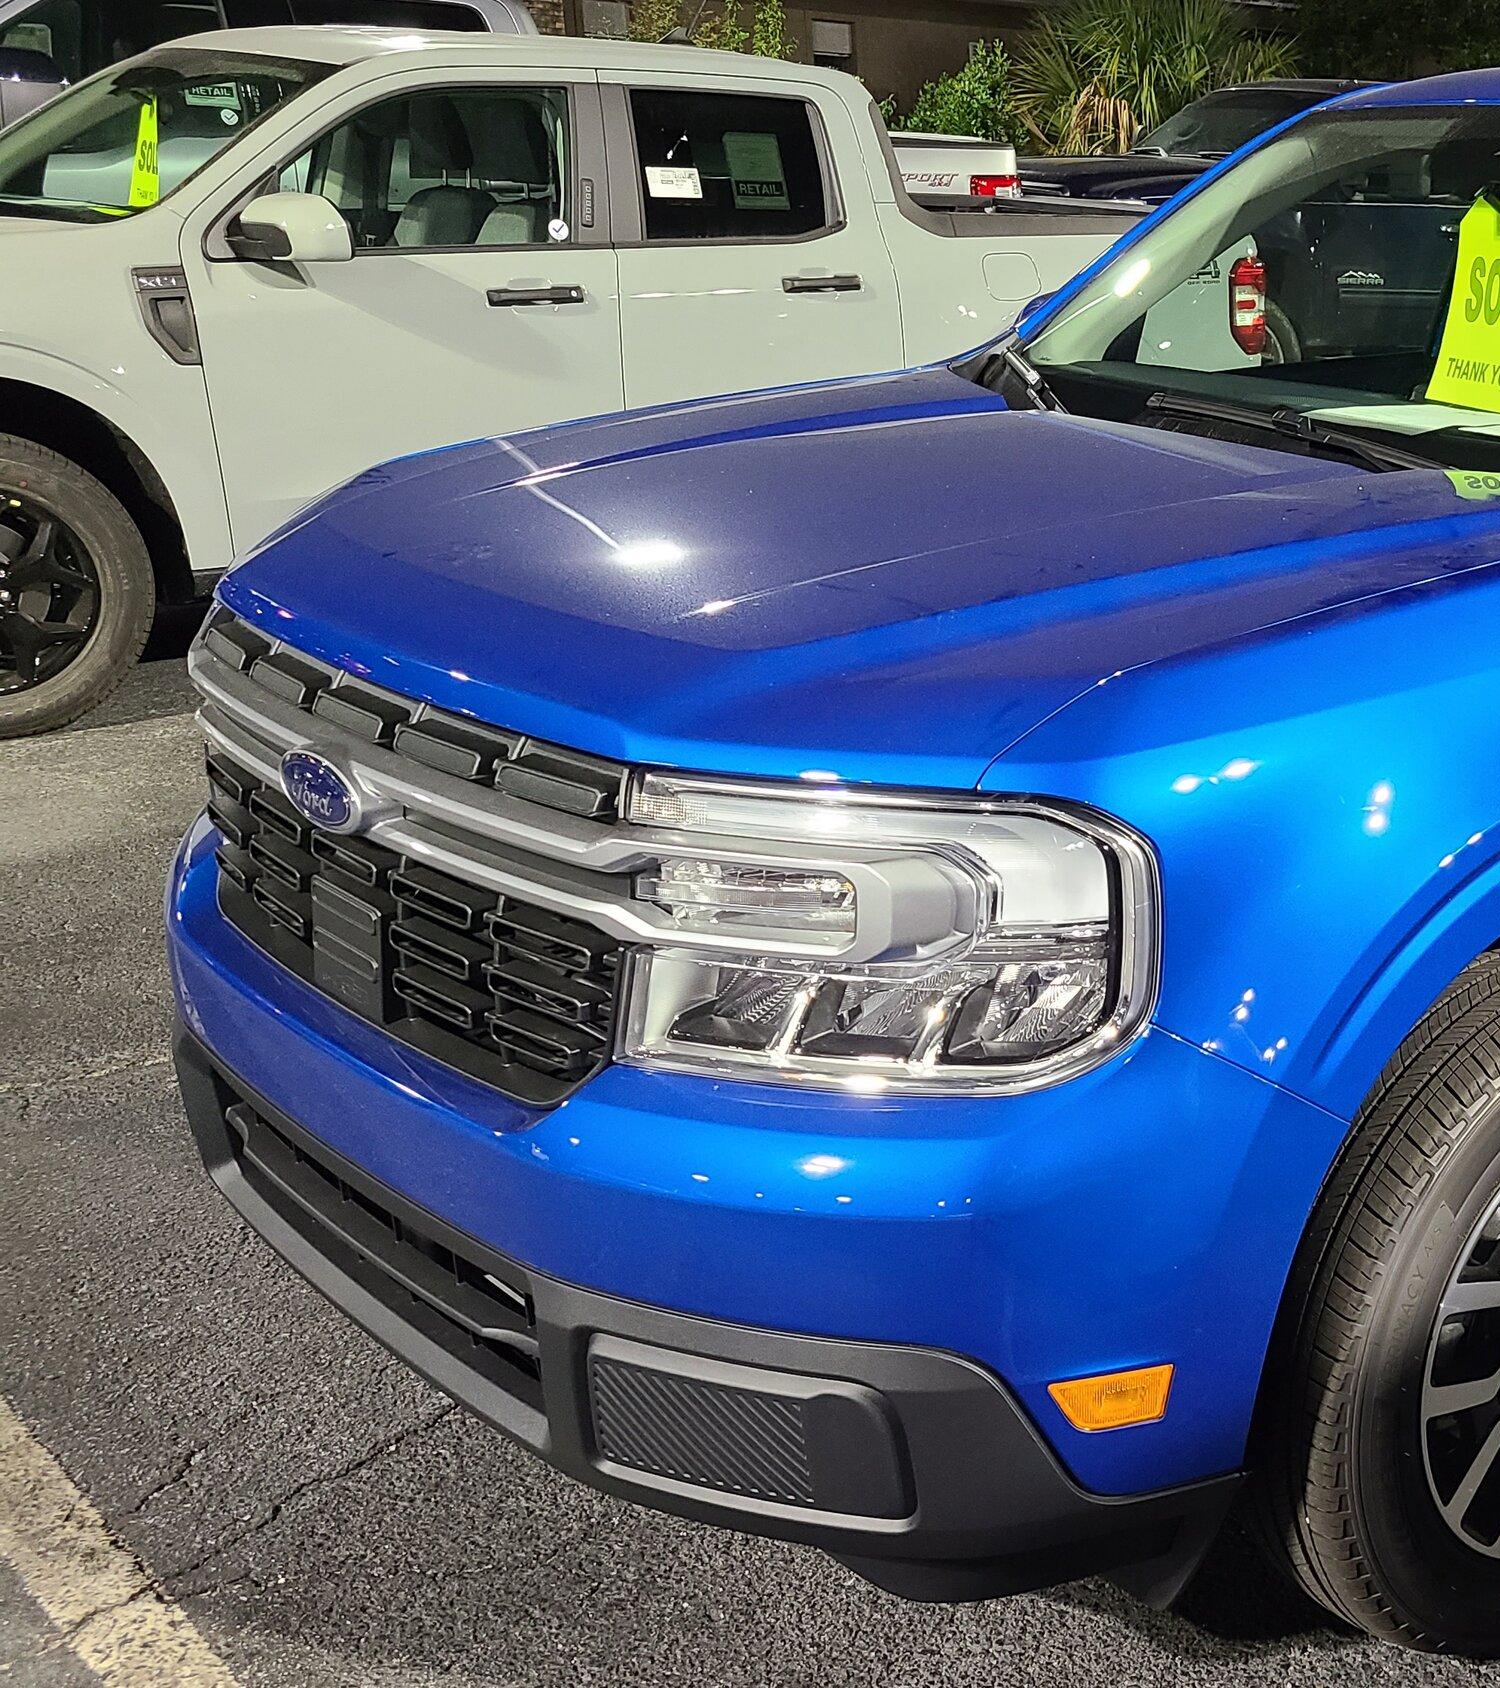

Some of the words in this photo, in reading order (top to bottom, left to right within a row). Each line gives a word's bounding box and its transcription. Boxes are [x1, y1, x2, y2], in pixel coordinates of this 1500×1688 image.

[138, 140, 158, 175] SOL
[738, 183, 781, 195] RETAIL
[1337, 277, 1384, 286] SIERRA
[1446, 357, 1489, 383] THANK
[291, 774, 333, 816] Ford
